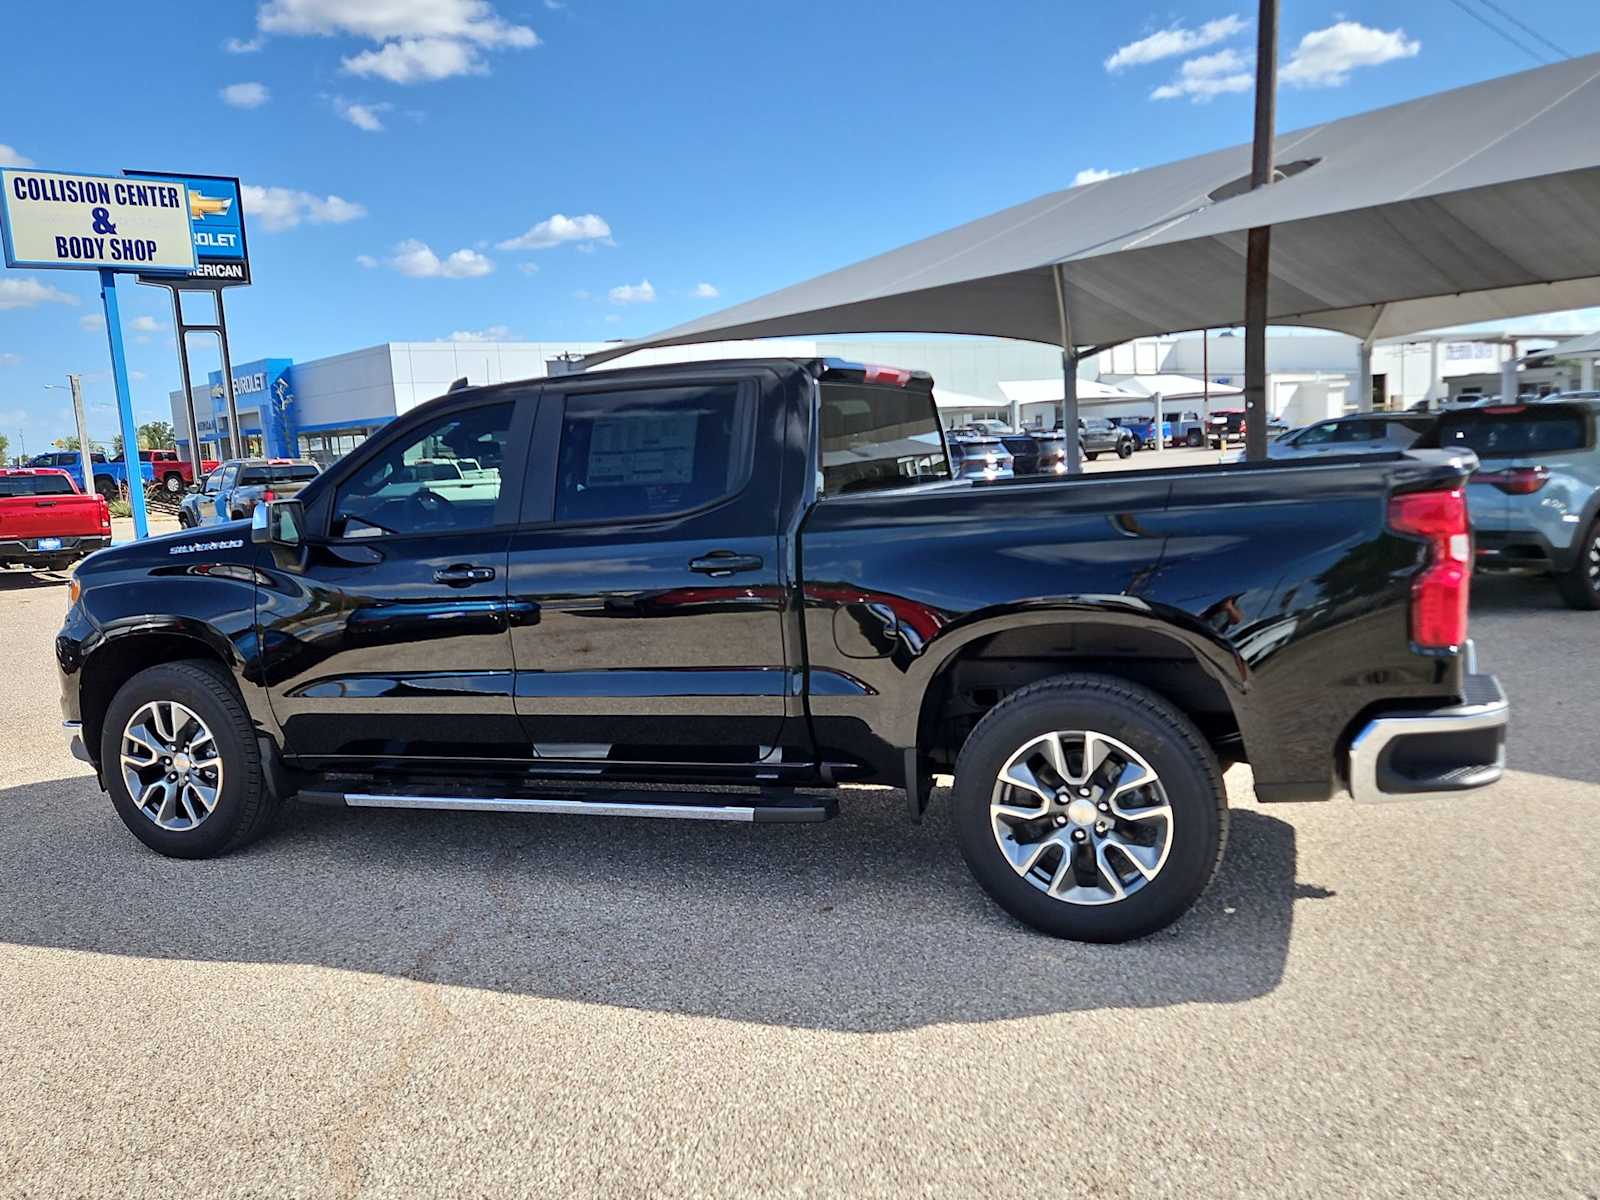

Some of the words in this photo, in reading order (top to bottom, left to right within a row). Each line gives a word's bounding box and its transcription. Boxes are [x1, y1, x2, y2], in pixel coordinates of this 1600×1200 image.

[13, 176, 112, 205] COLLISION
[114, 183, 180, 209] CENTER
[91, 207, 118, 235] &
[55, 235, 104, 260] BODY
[109, 238, 157, 262] SHOP
[194, 232, 237, 247] OLET
[169, 539, 244, 555] SILVERADO
